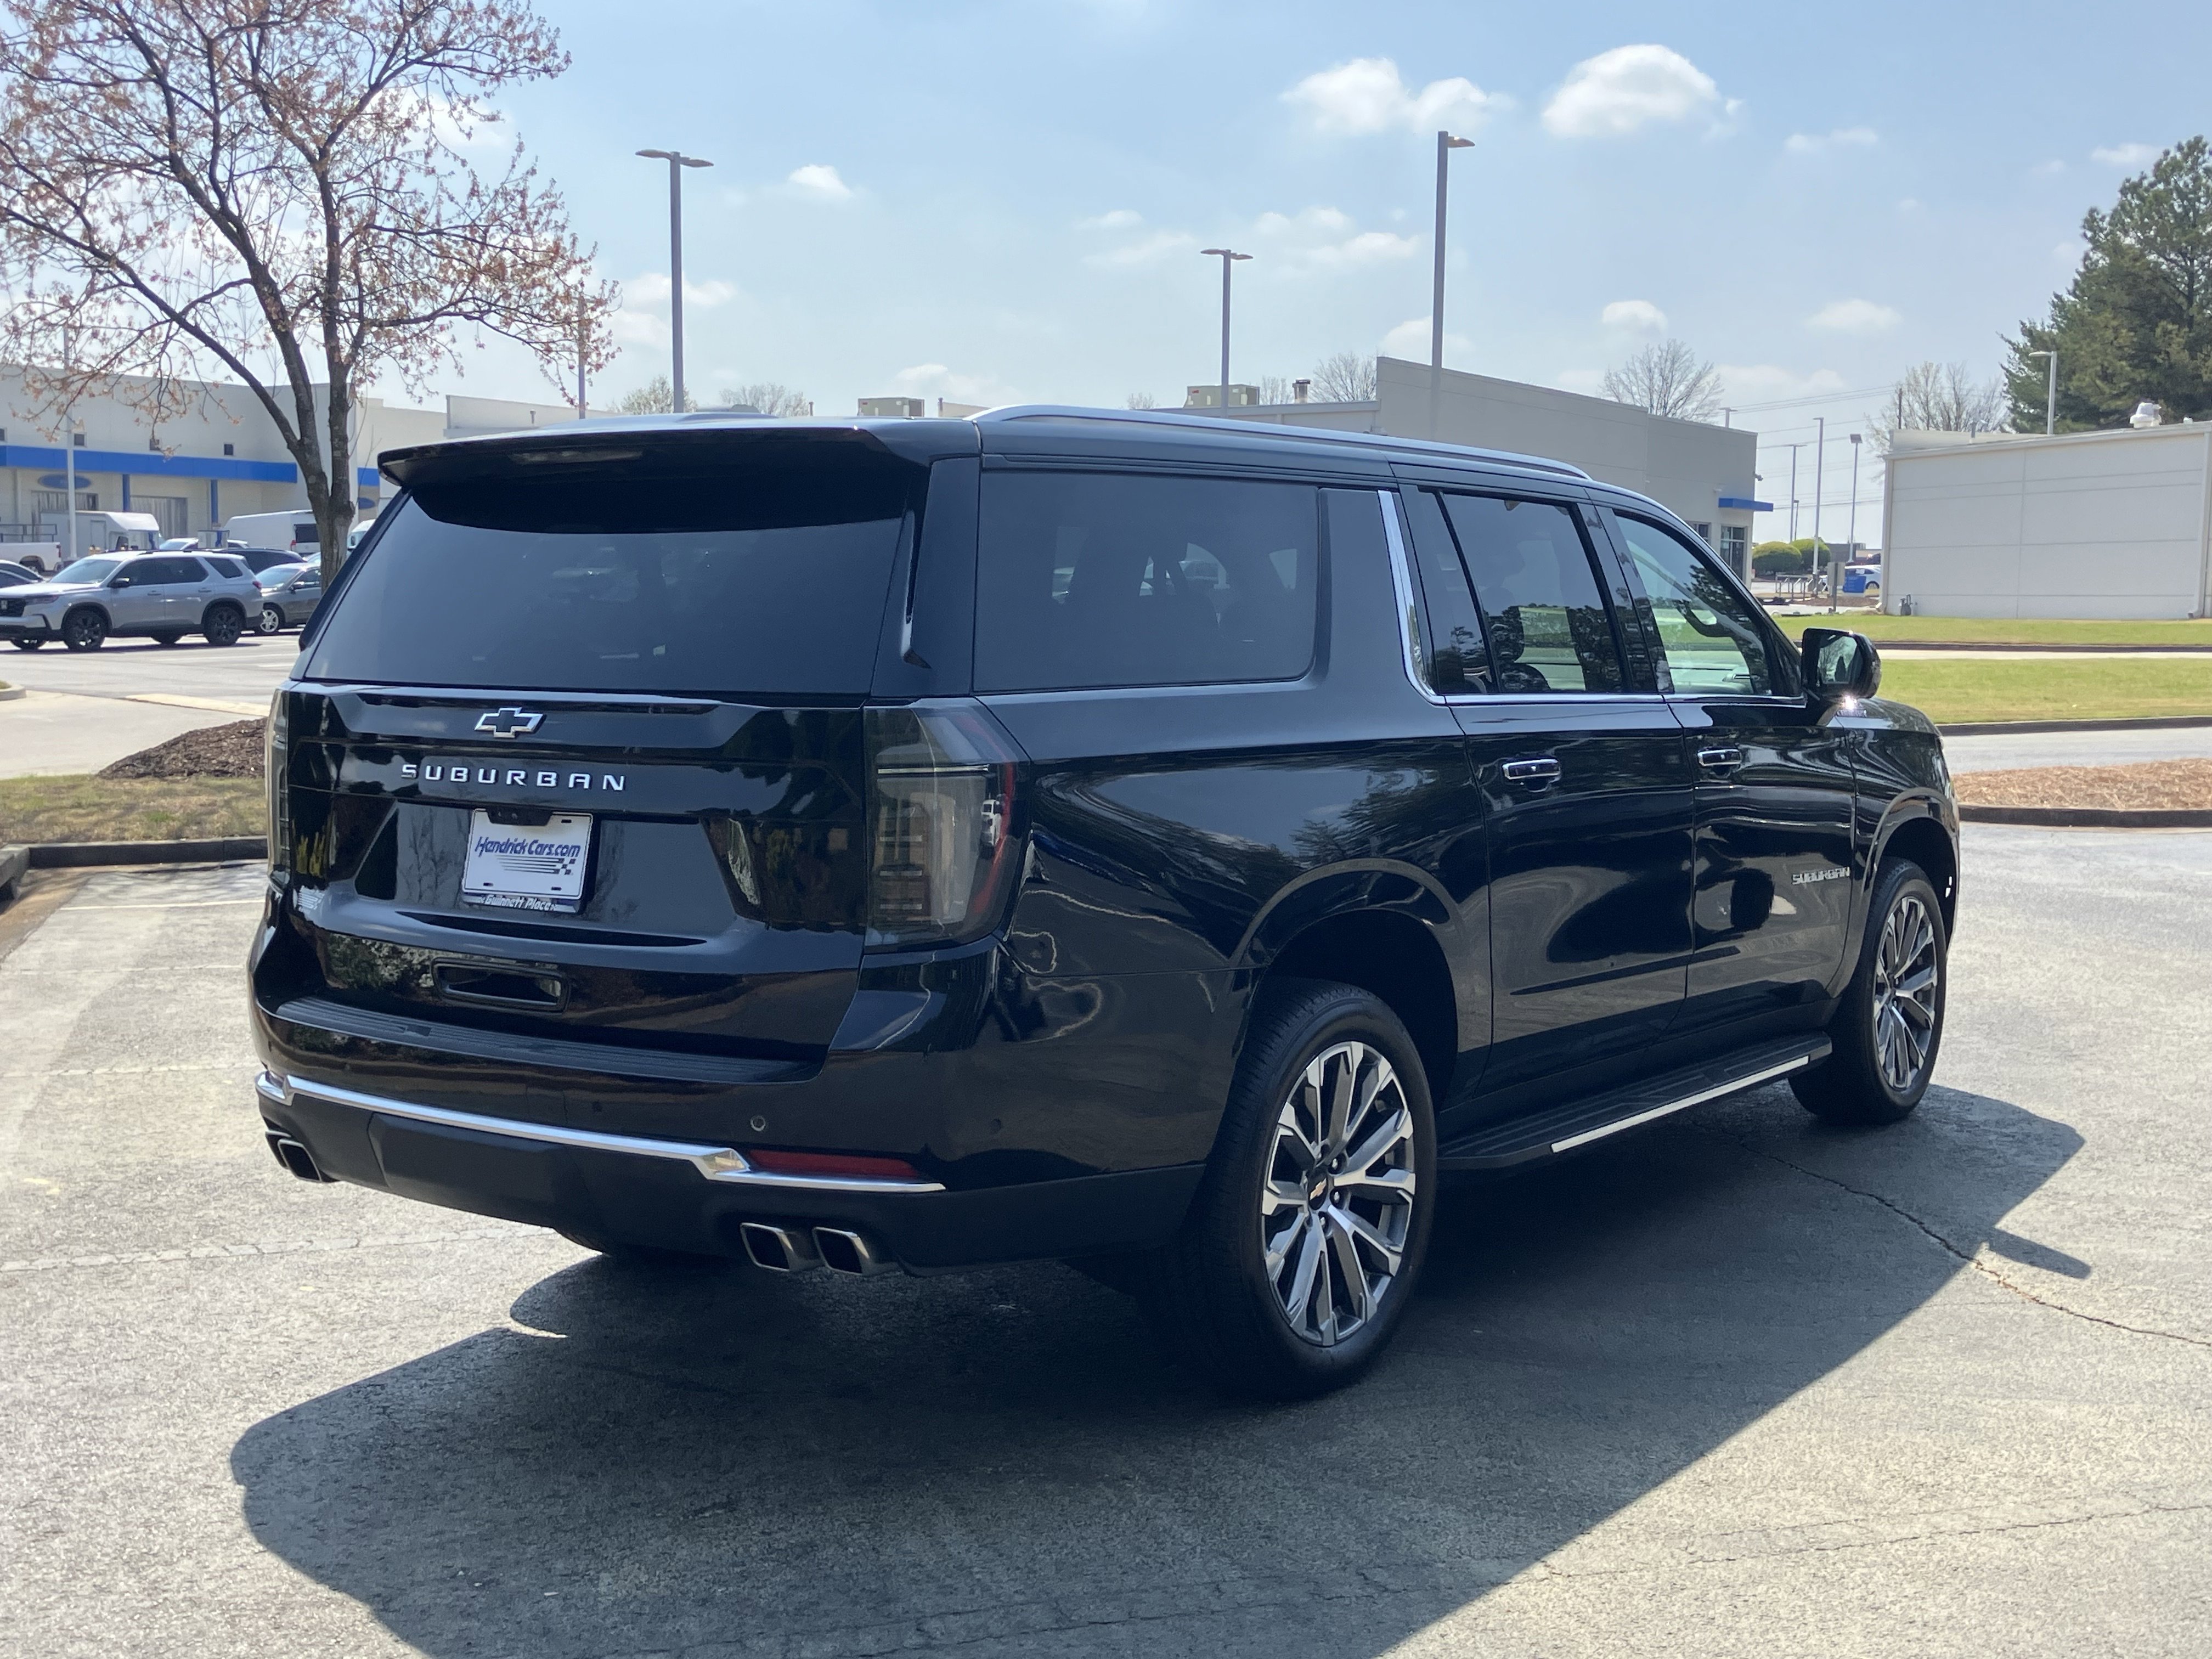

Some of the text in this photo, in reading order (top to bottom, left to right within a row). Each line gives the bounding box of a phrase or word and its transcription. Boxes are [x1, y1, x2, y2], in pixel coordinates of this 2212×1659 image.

[401, 764, 625, 791] SUBURBAN
[1792, 866, 1850, 885] SUBURBAN
[524, 898, 551, 911] Place
